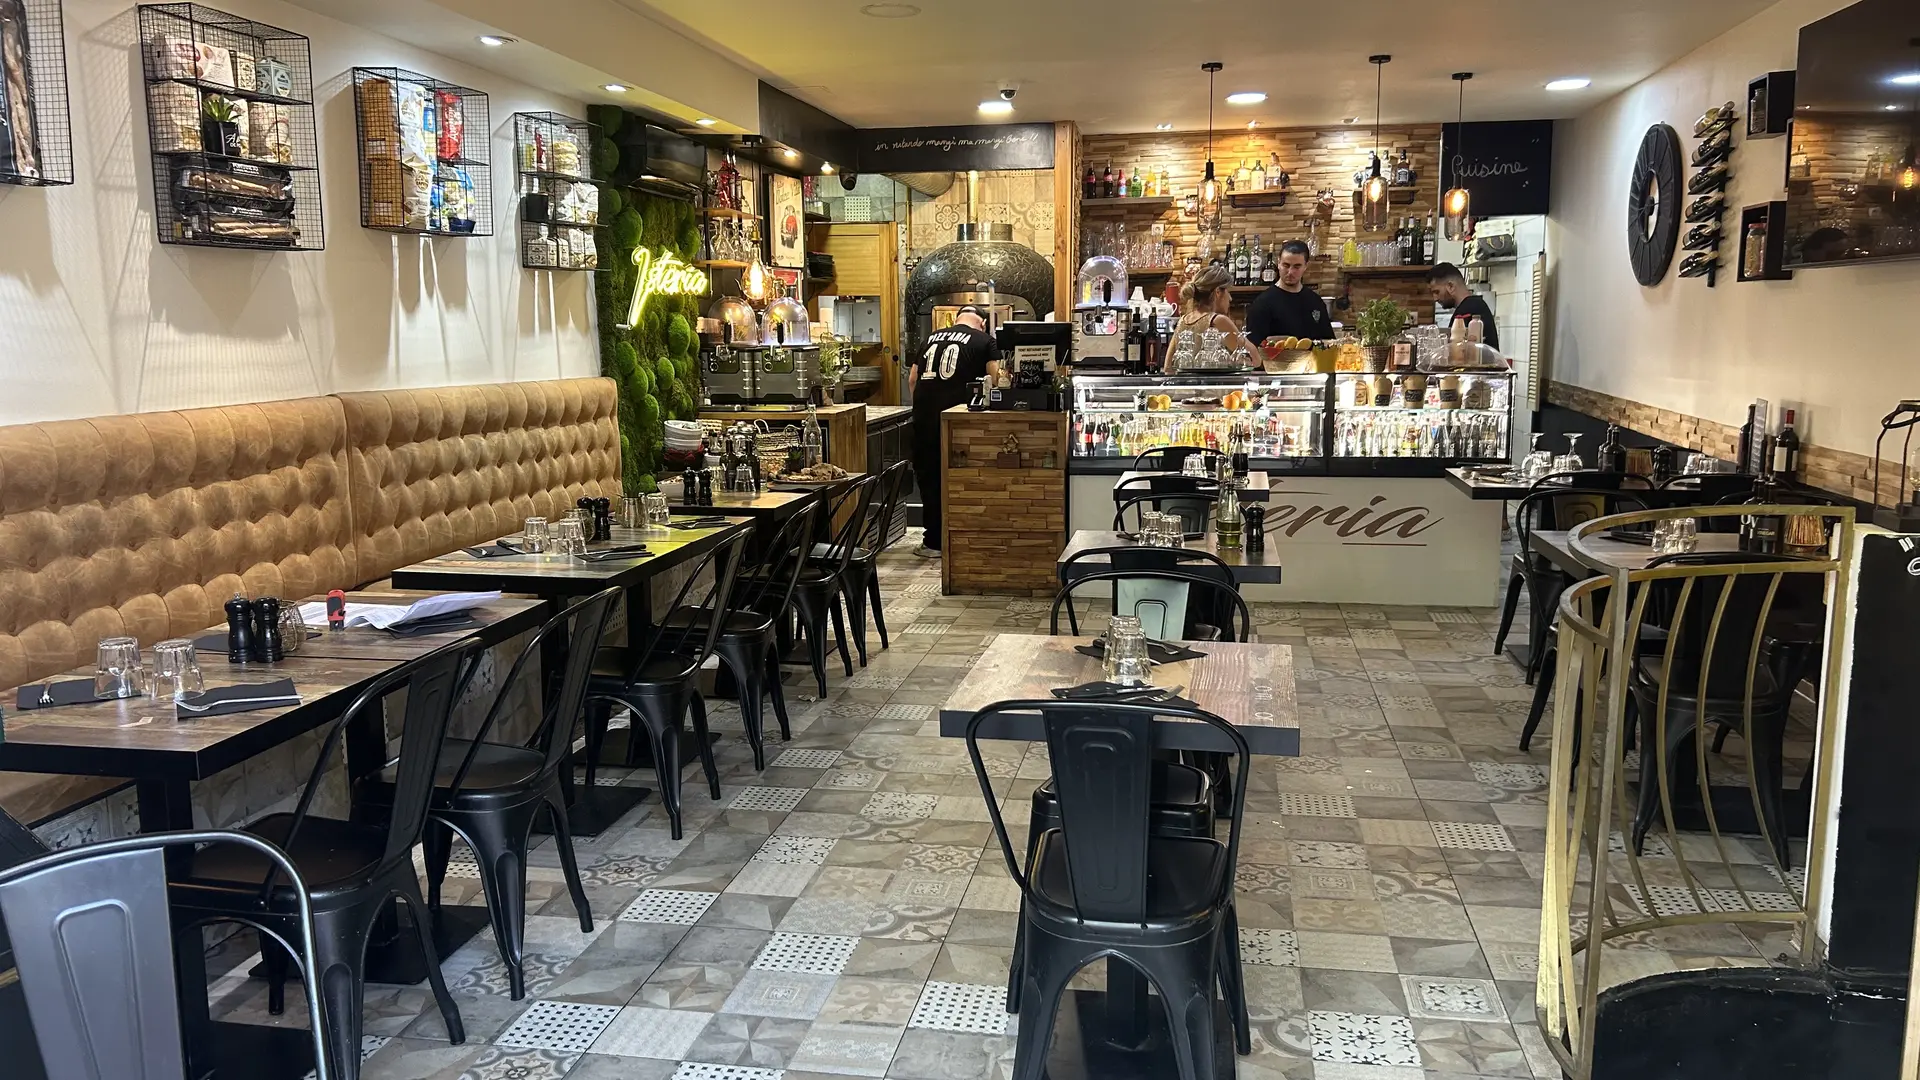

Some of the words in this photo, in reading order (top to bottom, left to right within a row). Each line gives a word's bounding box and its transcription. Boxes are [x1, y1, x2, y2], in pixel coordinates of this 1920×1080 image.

[1451, 154, 1529, 178] Cuisine
[927, 331, 972, 345] PIZZ'ARIA
[920, 343, 960, 381] 10
